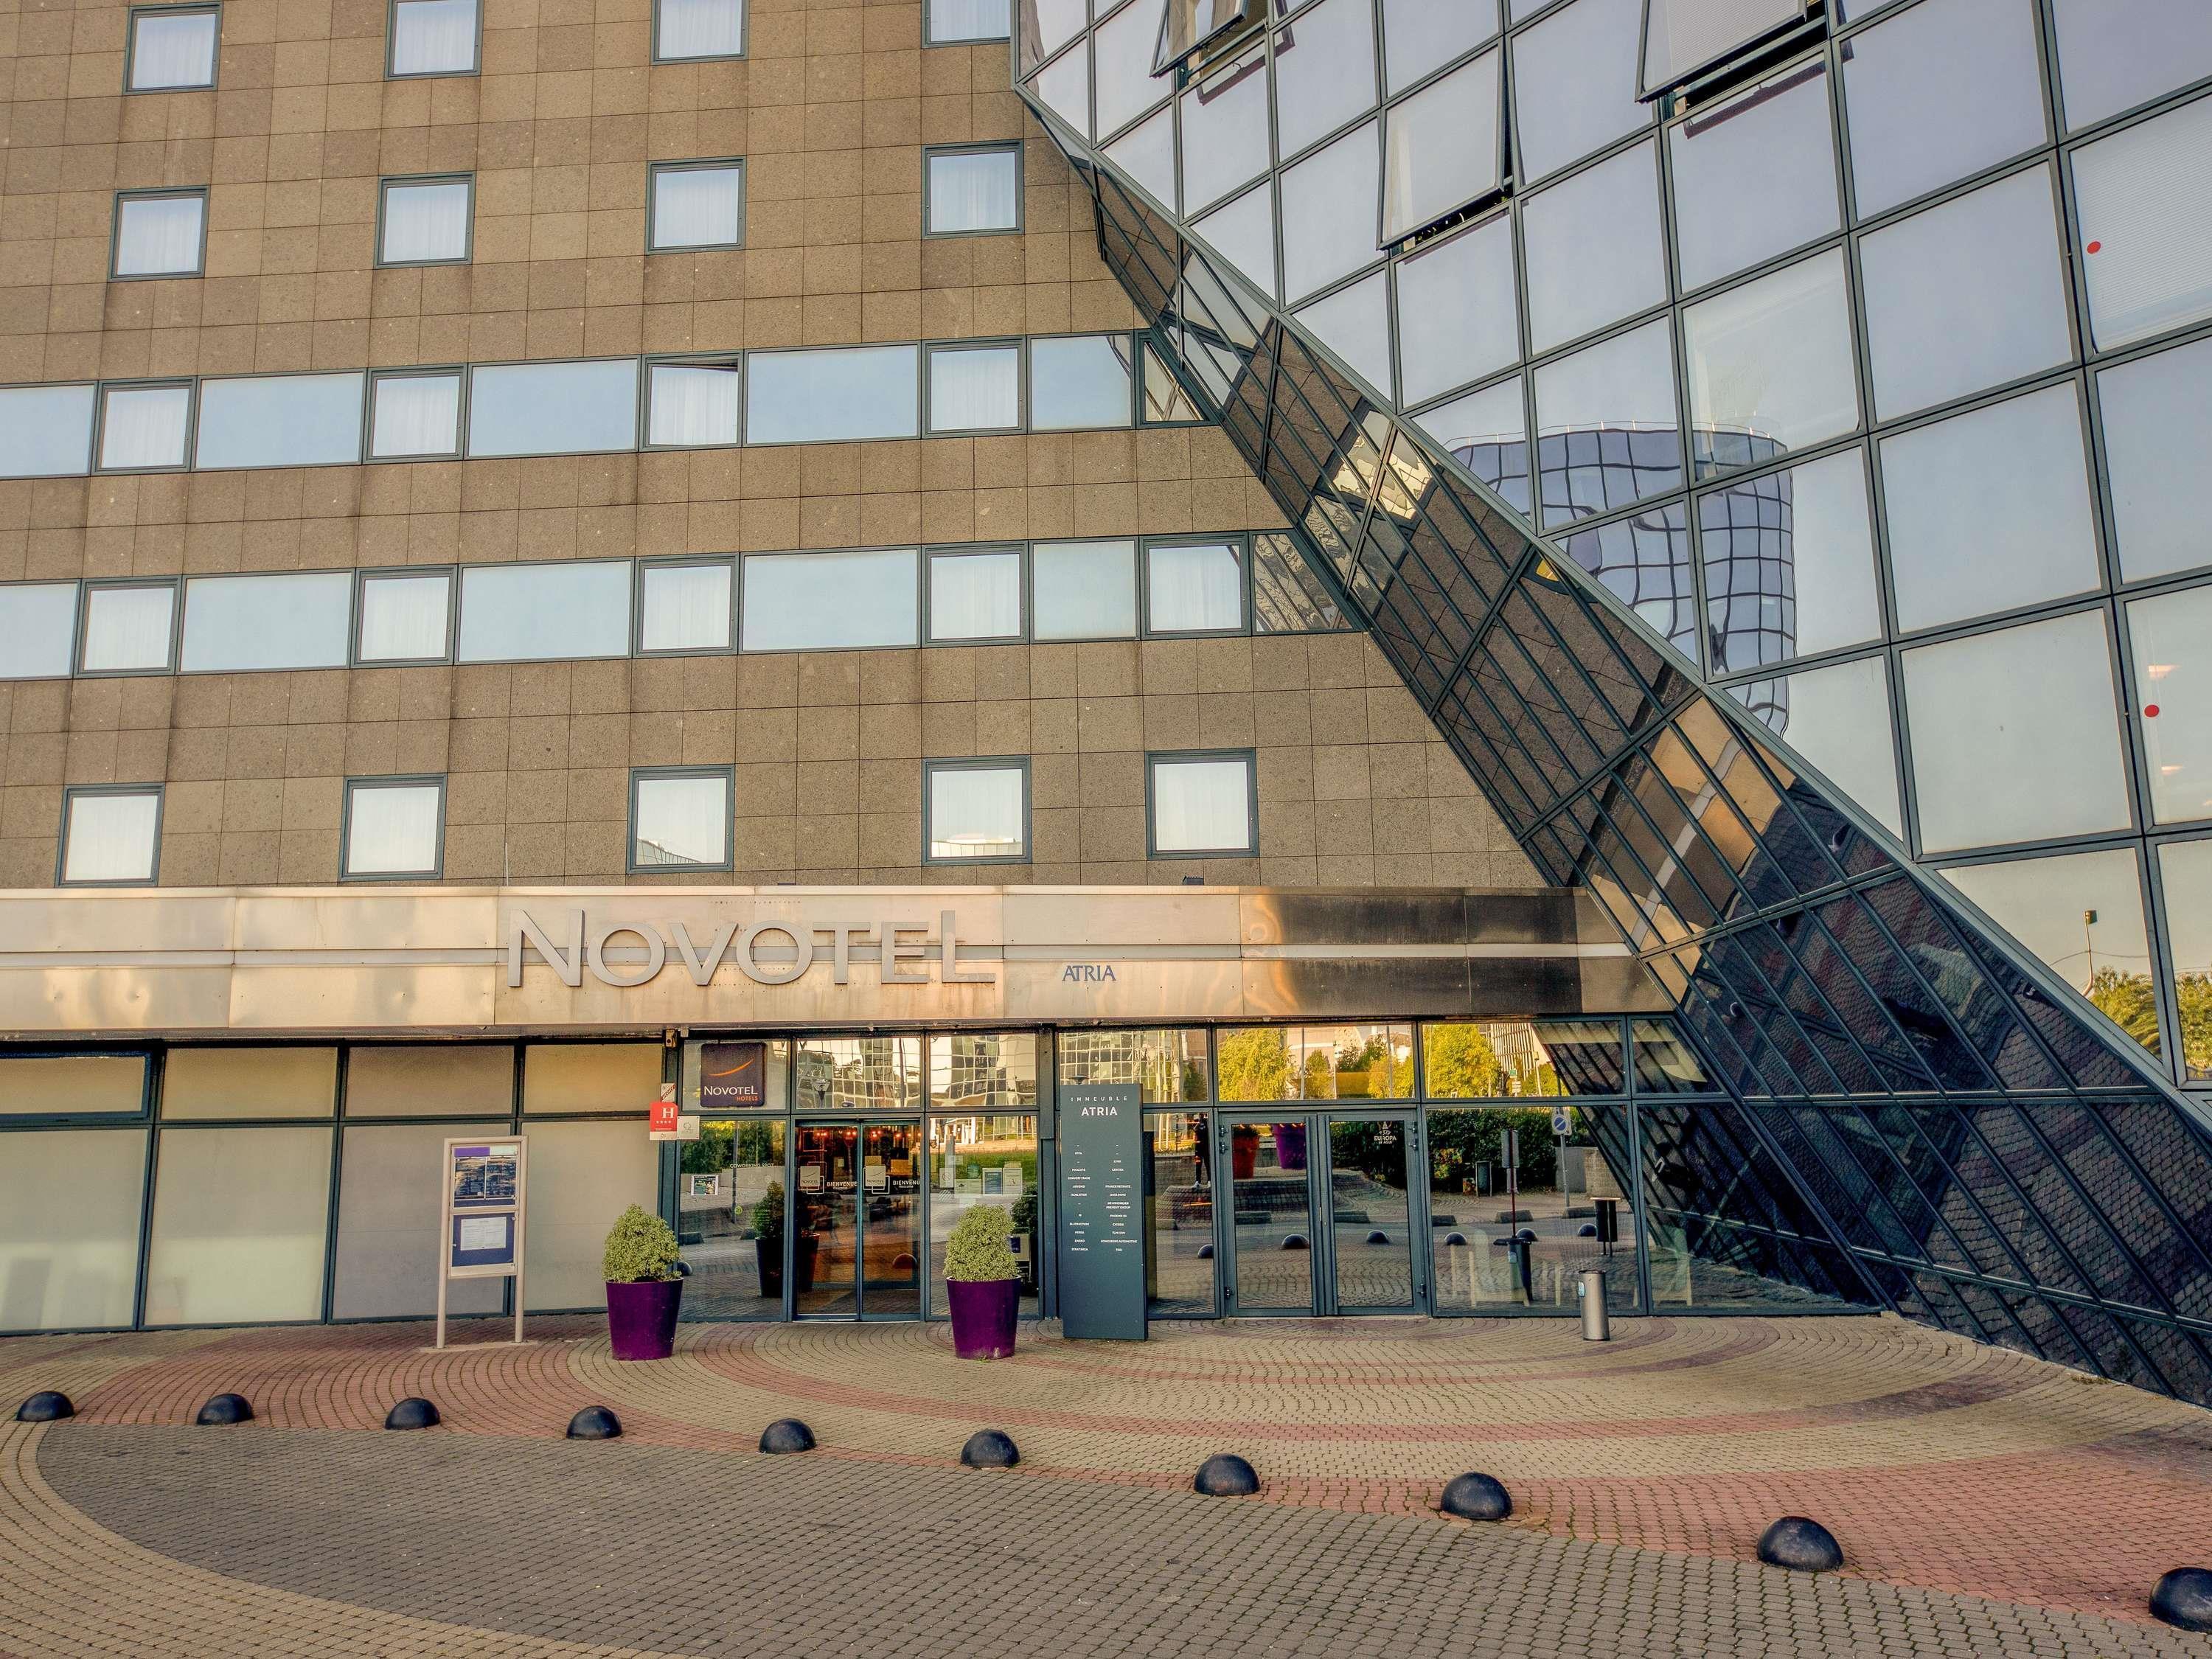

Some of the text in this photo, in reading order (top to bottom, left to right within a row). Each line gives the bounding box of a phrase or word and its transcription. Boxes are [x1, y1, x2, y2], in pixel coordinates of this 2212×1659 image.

[507, 908, 996, 987] NOVOTEL
[1062, 964, 1116, 981] ATRIA
[703, 1085, 759, 1096] NOVOTEL
[661, 1107, 675, 1119] H
[1081, 1106, 1118, 1116] ATRIA
